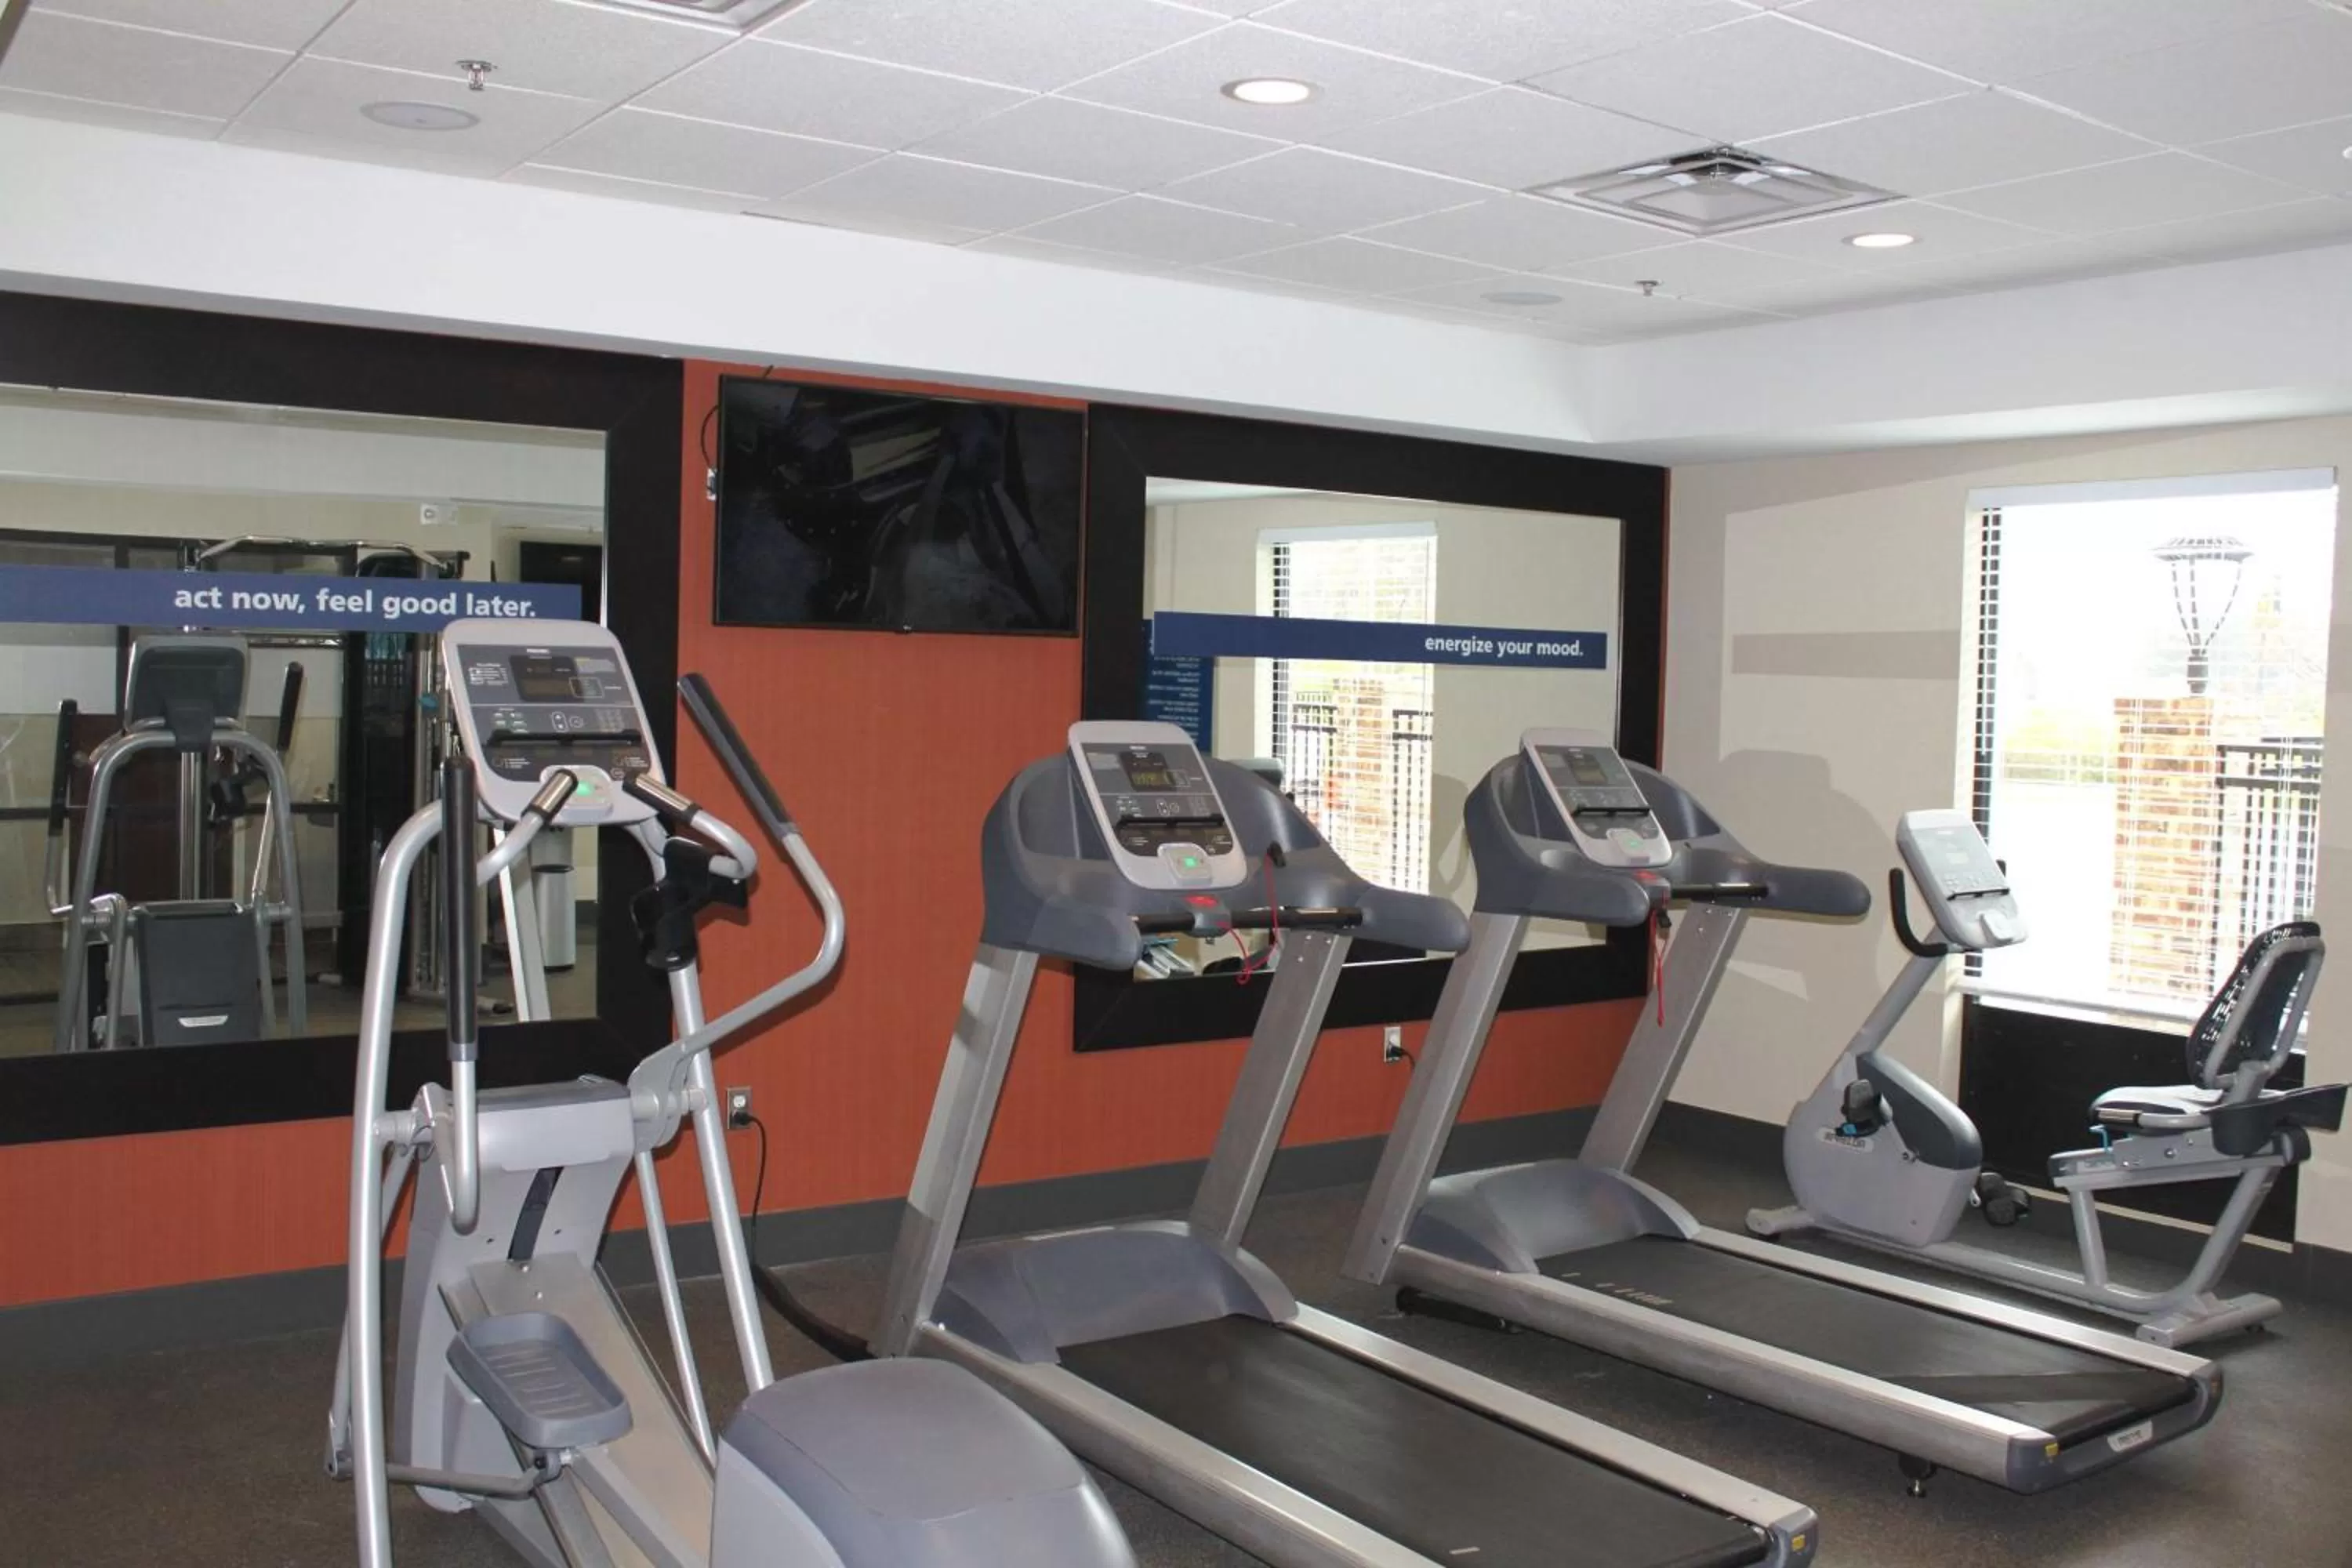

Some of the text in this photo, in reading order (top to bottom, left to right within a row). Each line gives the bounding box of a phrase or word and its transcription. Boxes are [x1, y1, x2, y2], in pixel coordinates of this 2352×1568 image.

[175, 587, 536, 619] act now, feel good later.
[1425, 636, 1584, 658] energize your mood.
